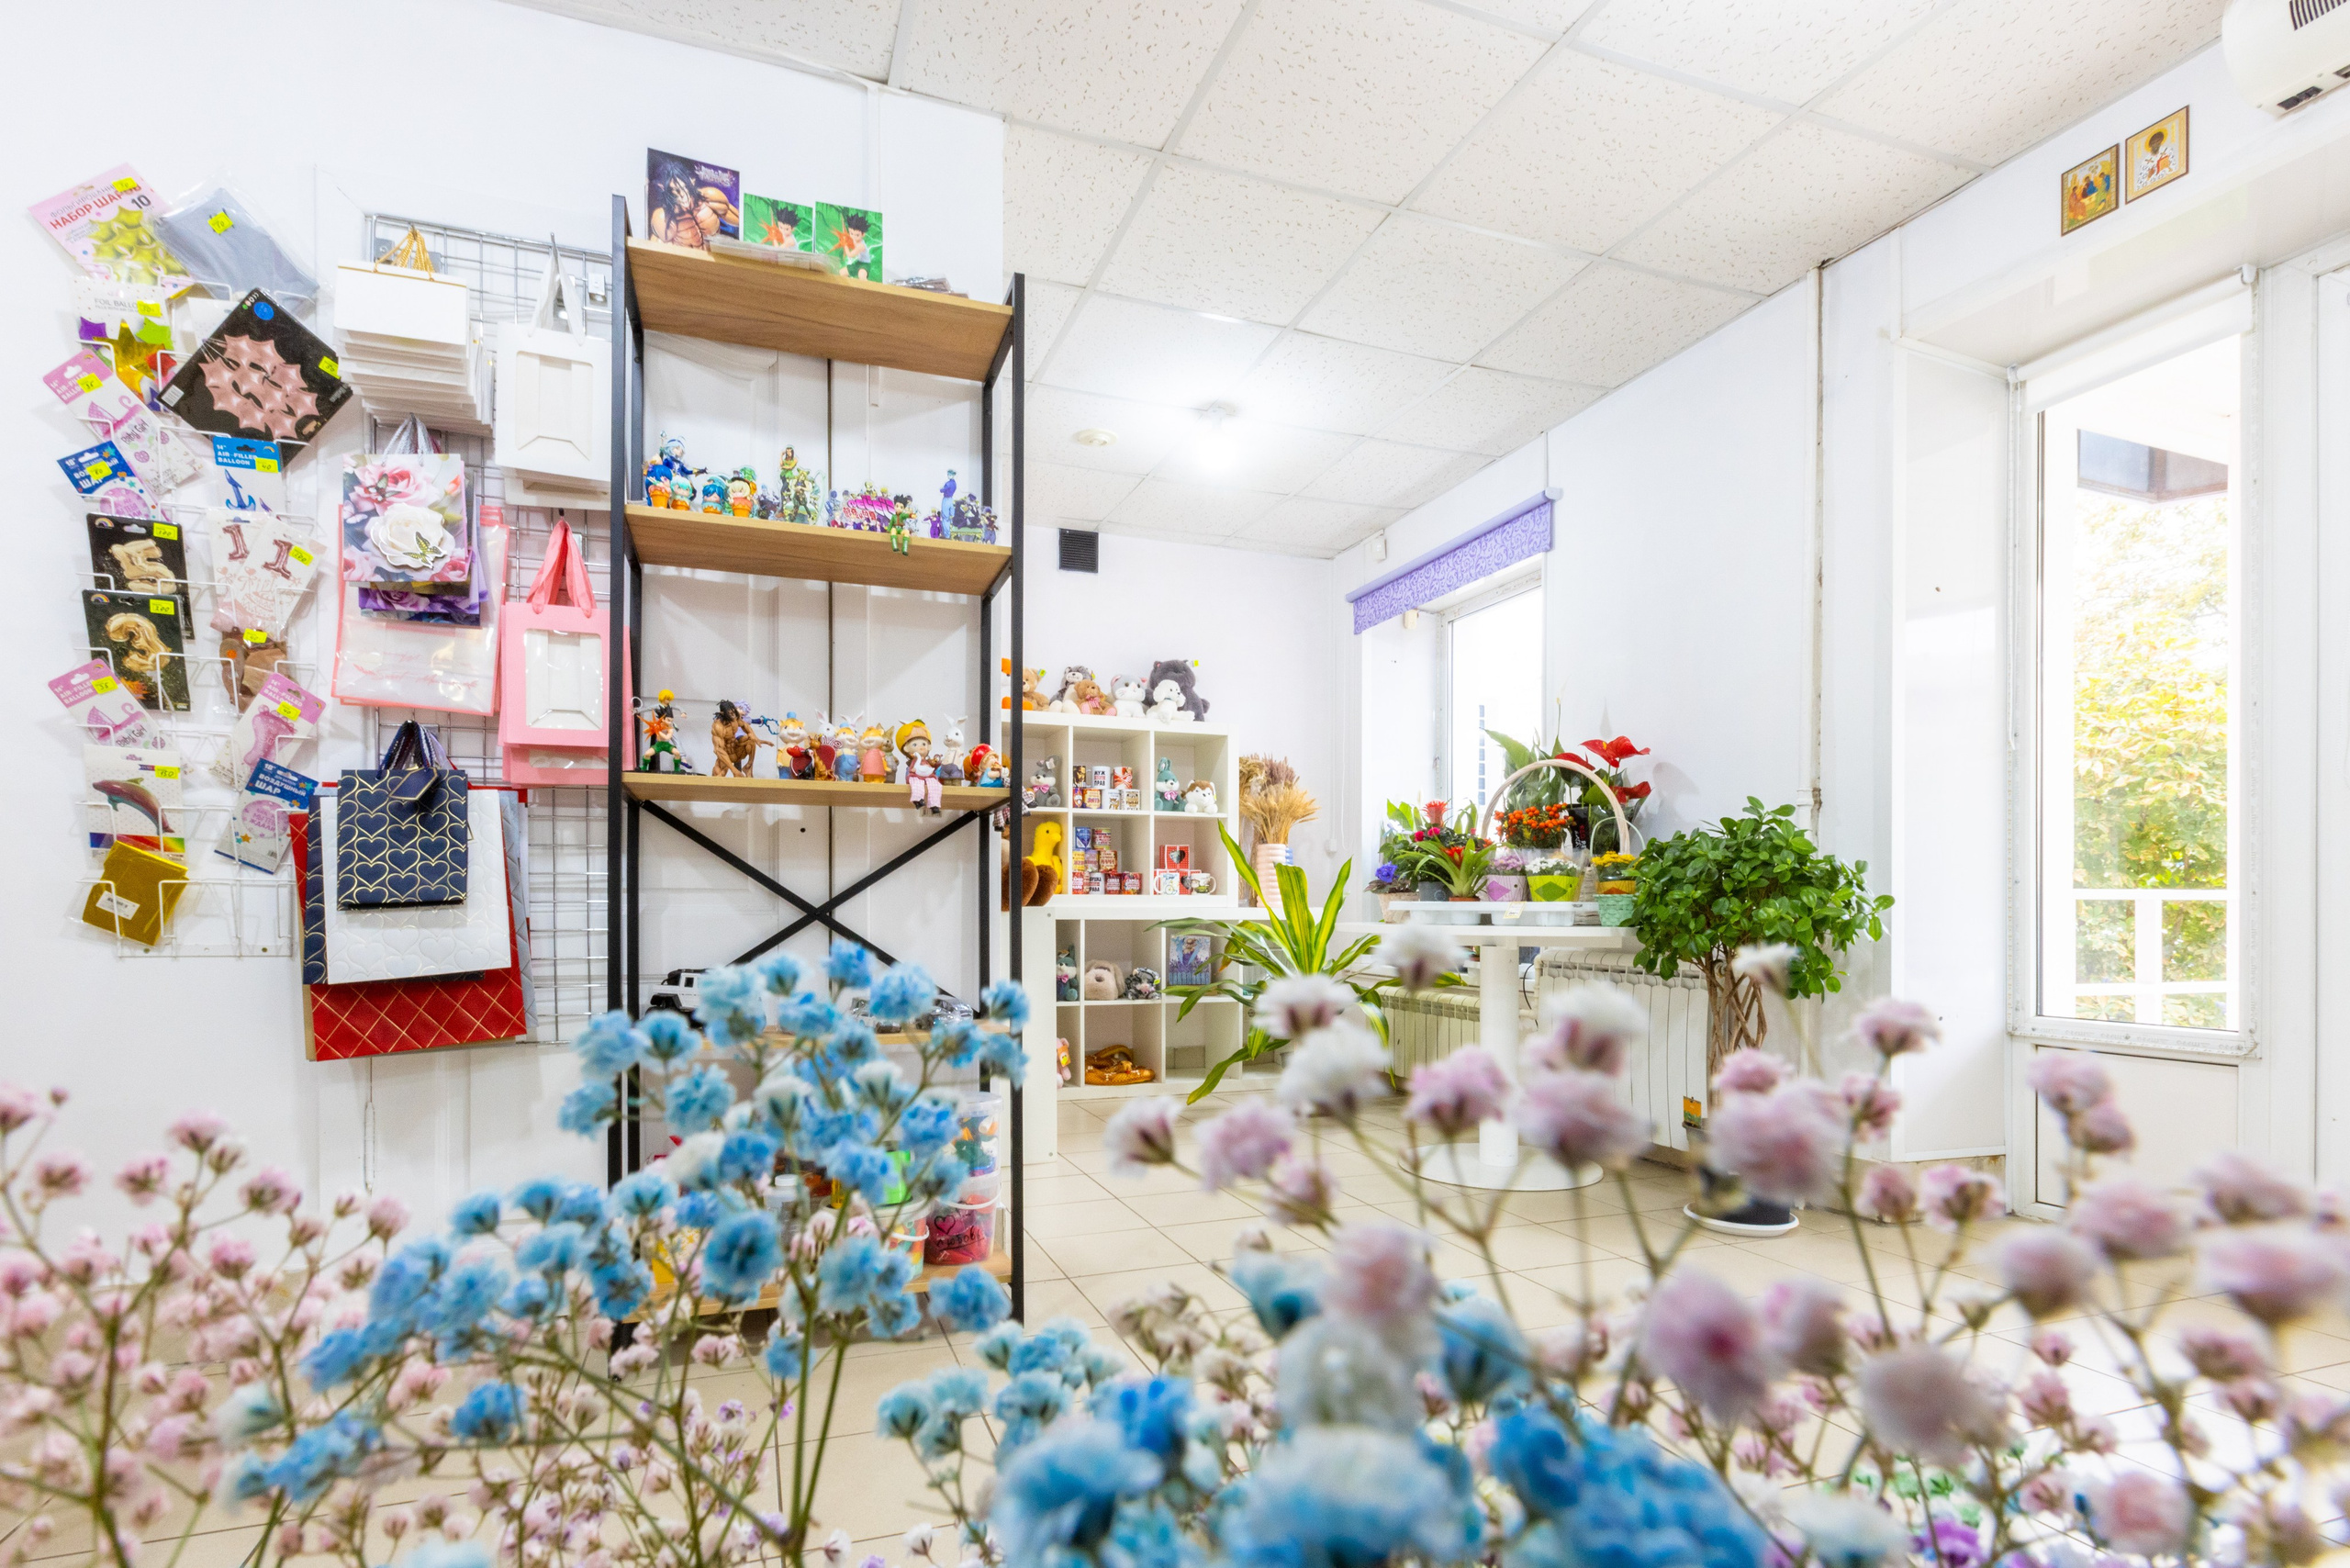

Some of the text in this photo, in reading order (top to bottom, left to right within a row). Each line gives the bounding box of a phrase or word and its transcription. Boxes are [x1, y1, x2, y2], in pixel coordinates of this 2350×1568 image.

[50, 184, 115, 218] ФОЛЬГИРОВАНН
[131, 195, 151, 209] 10
[49, 203, 93, 230] НАБОР
[94, 298, 138, 309] FOIL BALLO
[61, 386, 83, 401] BALLO
[120, 429, 141, 445] Baby
[217, 456, 251, 466] BALLOON
[60, 679, 93, 700] AIR-FILLE
[116, 733, 138, 748] Baby
[254, 779, 282, 795] ШАР
[258, 773, 308, 797] ВОЗДУШНЫЙ
